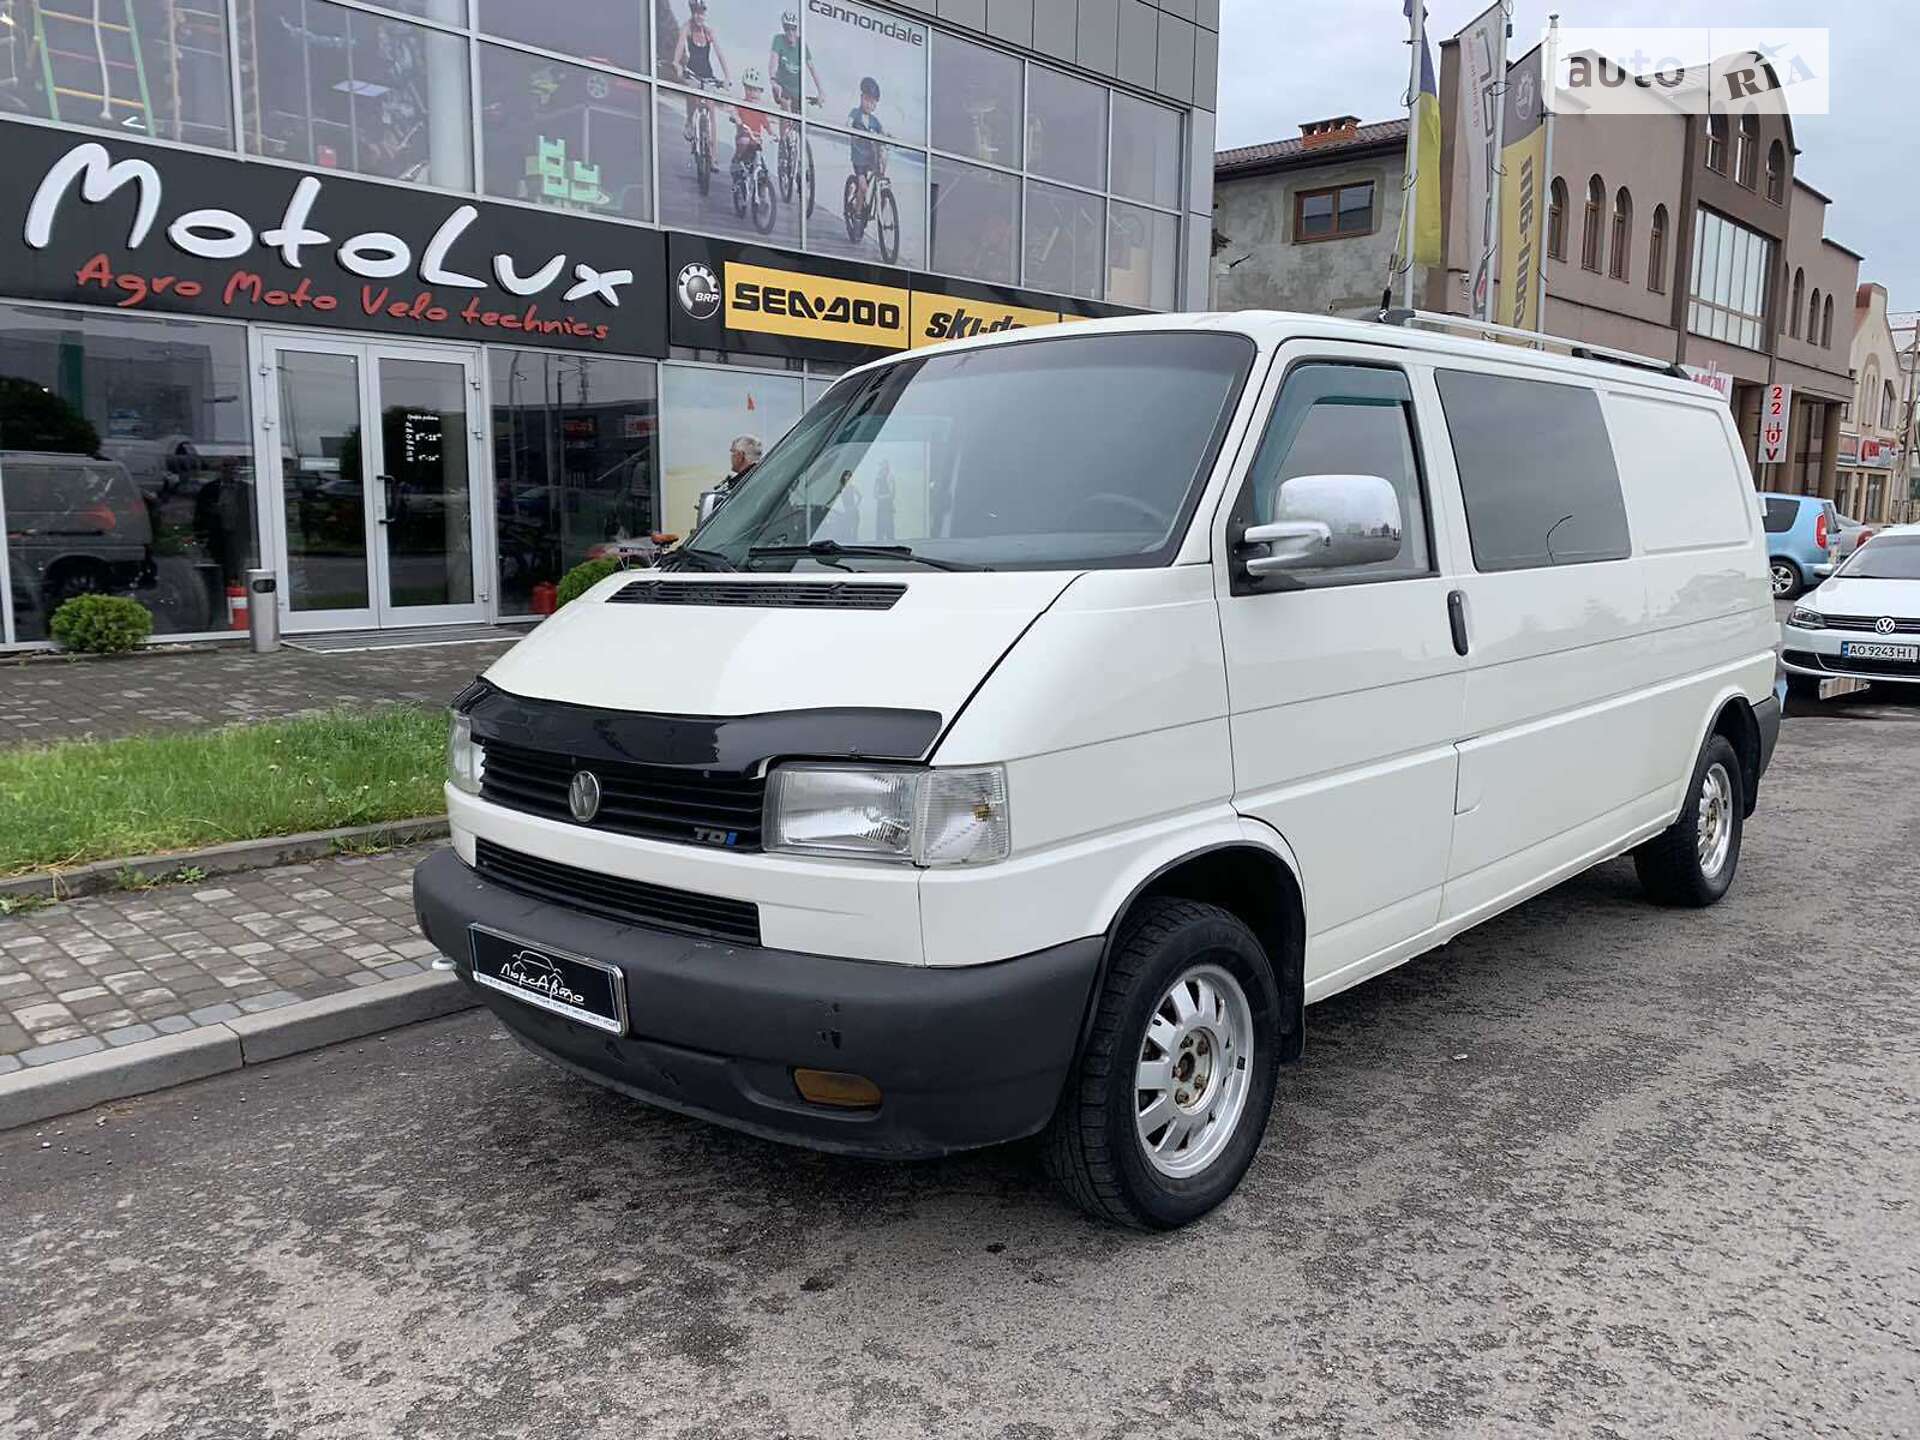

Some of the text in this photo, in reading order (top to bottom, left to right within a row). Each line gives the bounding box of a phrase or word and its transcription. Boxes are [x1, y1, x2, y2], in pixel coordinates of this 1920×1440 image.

[808, 0, 922, 46] cannondale
[24, 142, 634, 306] MotoLux
[76, 253, 609, 341] Agro Moto Velo technics
[695, 292, 720, 302] BRP
